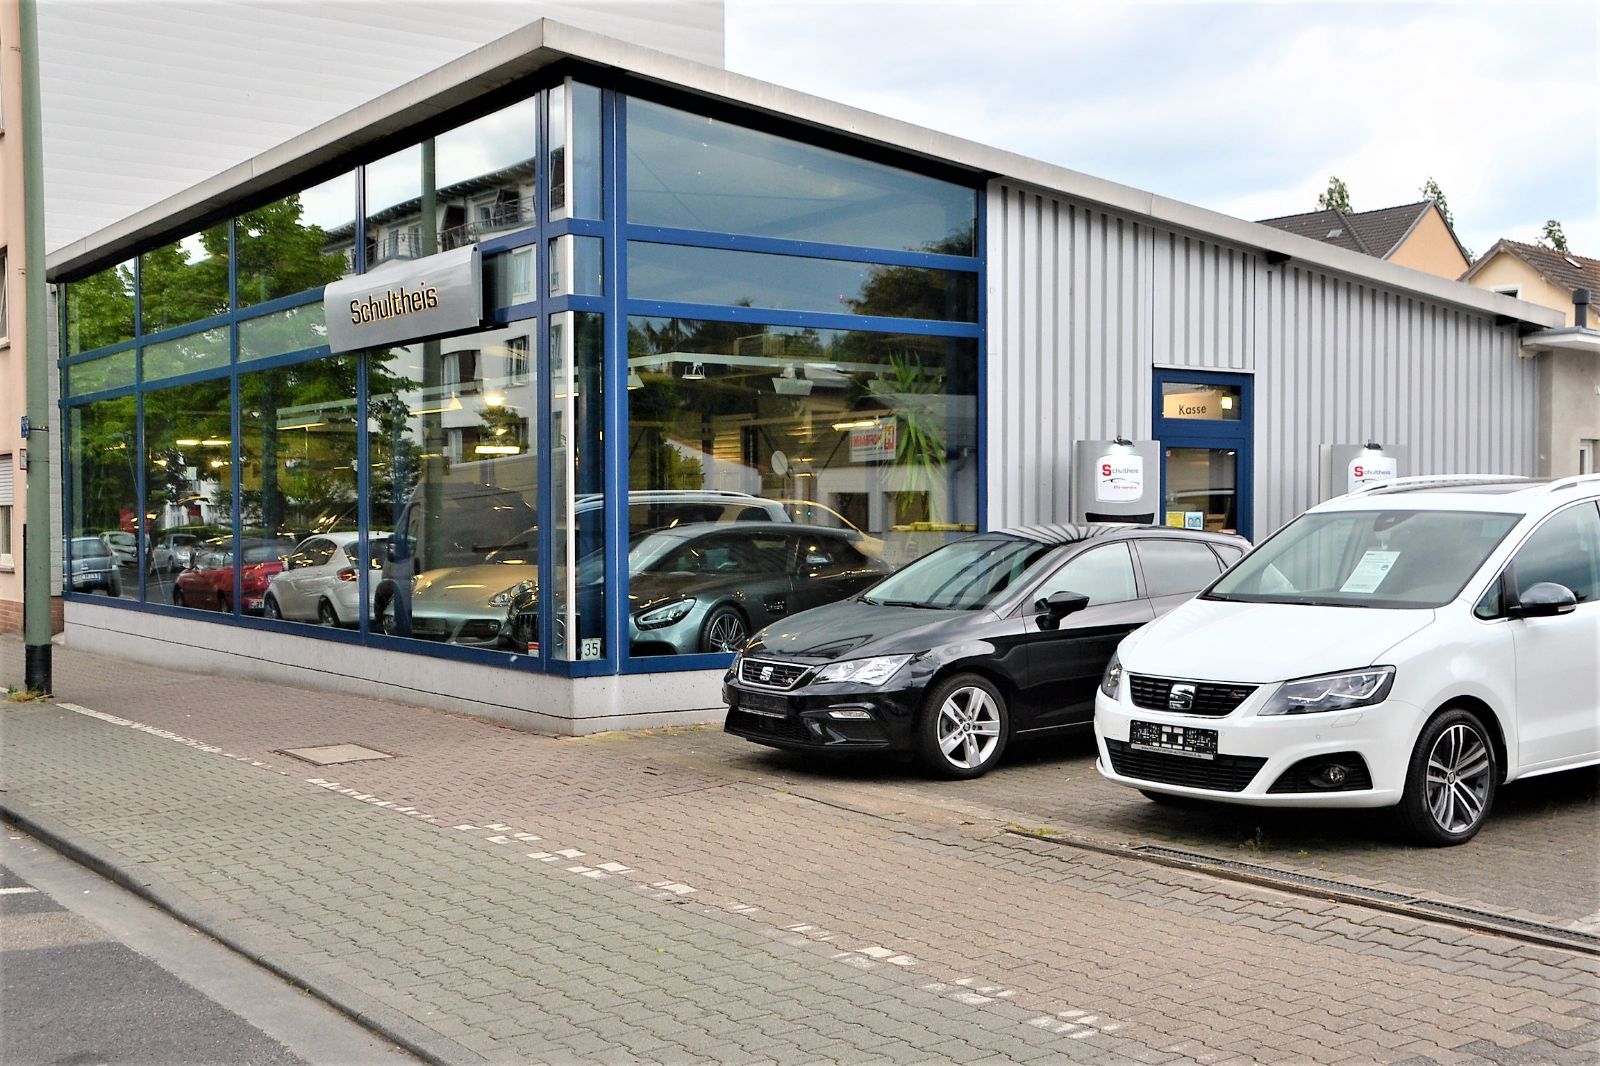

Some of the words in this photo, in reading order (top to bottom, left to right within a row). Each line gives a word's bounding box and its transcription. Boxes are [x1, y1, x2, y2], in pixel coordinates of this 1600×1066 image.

[350, 281, 438, 325] Schultheis
[1178, 404, 1207, 415] Kasse
[584, 643, 599, 656] 35
